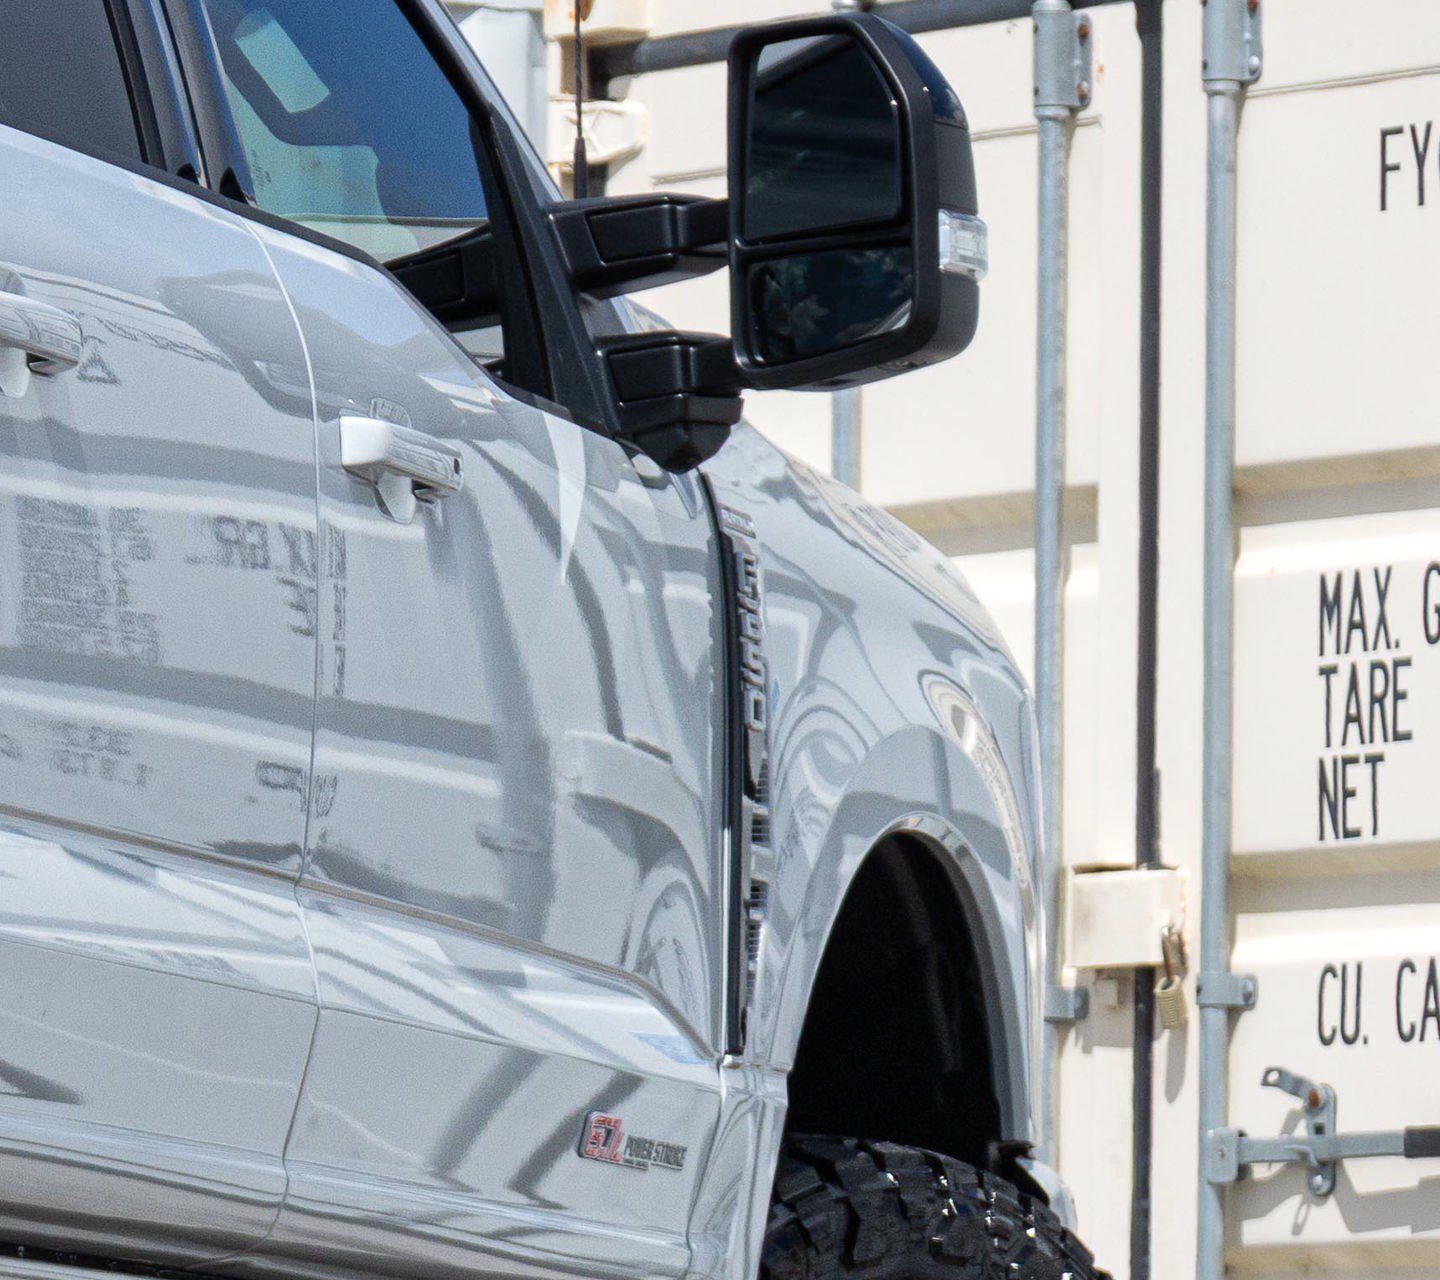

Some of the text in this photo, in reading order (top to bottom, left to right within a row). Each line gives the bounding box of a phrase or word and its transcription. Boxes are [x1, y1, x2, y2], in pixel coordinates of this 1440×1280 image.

[1317, 566, 1401, 657] MAX.
[1317, 656, 1414, 748] TARE
[1317, 753, 1385, 843] NET
[1316, 961, 1369, 1047] CU.
